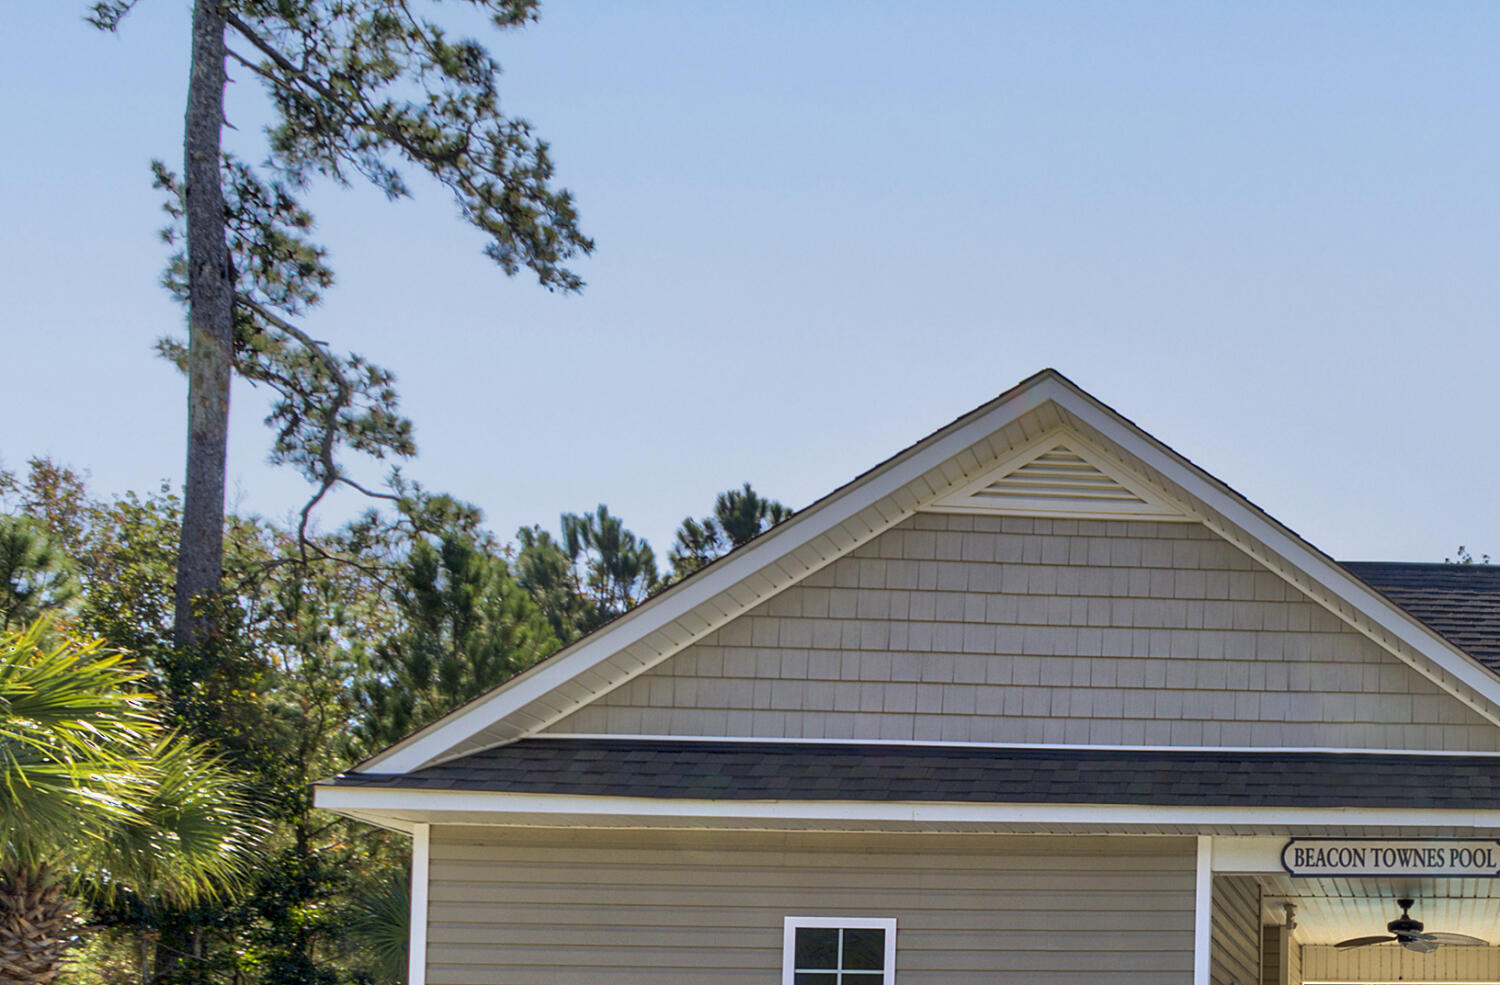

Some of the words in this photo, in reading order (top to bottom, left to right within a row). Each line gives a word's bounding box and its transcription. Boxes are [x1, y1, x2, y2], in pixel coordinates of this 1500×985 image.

[1294, 847, 1366, 868] BEACON
[1370, 847, 1445, 868] TOWNES
[1449, 847, 1497, 868] POOL
